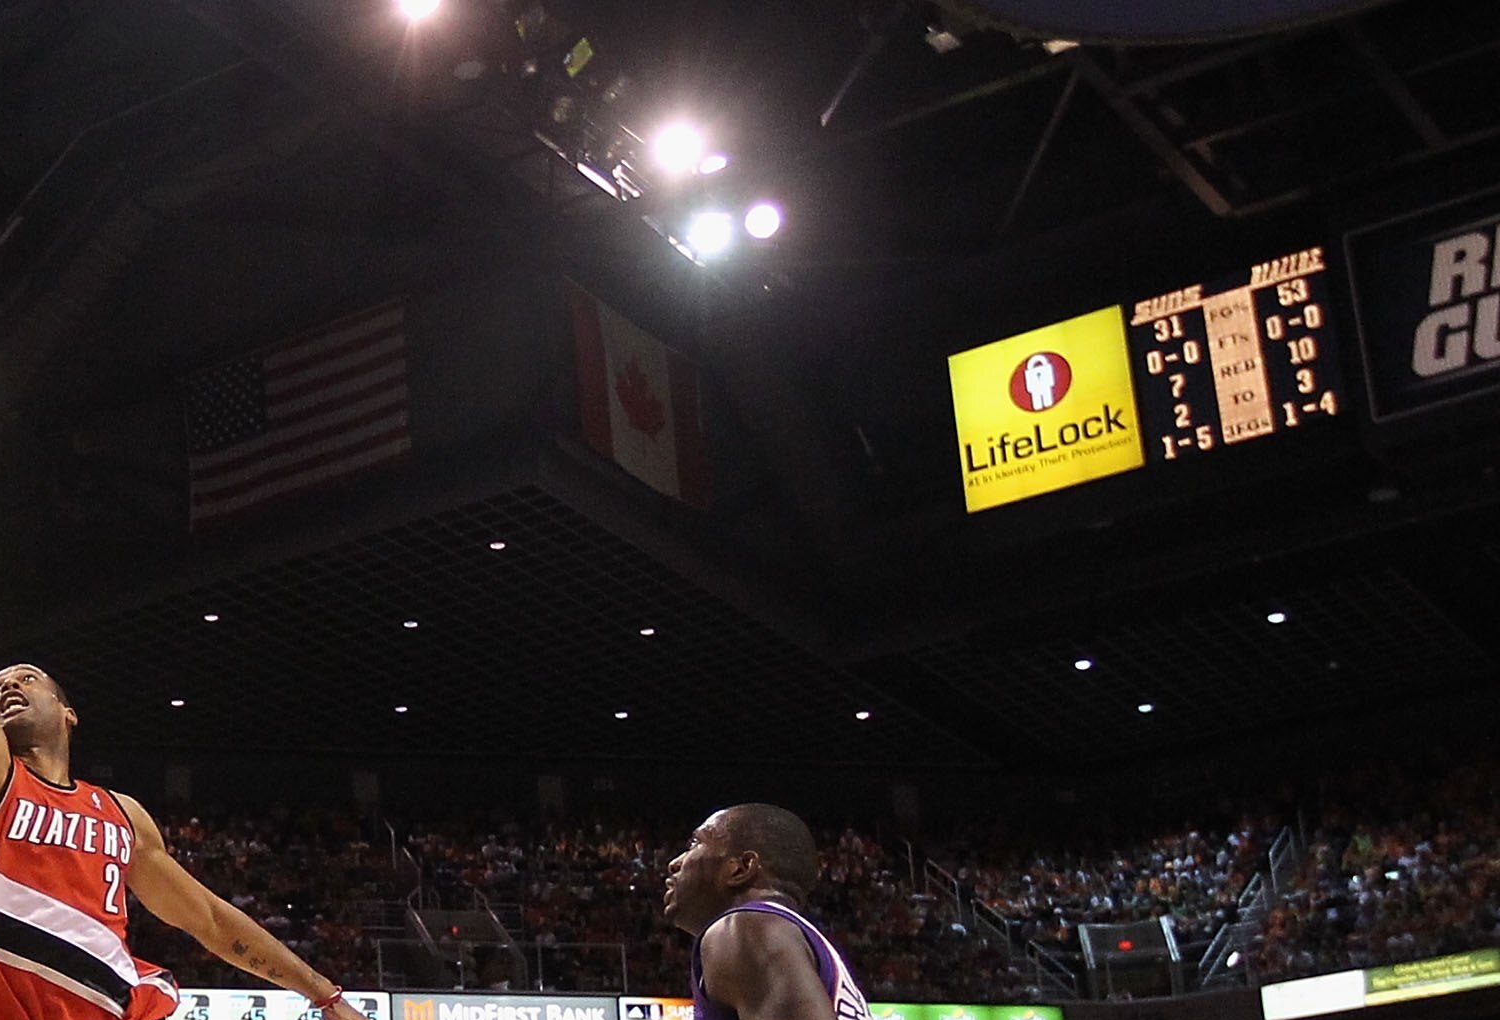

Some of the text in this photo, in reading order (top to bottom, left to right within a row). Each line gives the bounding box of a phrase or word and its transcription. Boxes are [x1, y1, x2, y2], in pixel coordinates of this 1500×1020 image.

[1146, 340, 1200, 375] 0-0
[1265, 304, 1322, 340] 0-0
[1154, 315, 1184, 342] 31
[1277, 278, 1308, 306] 53
[1168, 373, 1185, 398] 7
[1287, 336, 1317, 365] 10
[1173, 368, 1314, 428] 2 TO 3
[965, 404, 1127, 473] LifeLock
[1161, 425, 1213, 459] 1-5
[1282, 390, 1337, 427] 1-4
[7, 797, 134, 865] BLAZERS
[104, 862, 120, 914] 2
